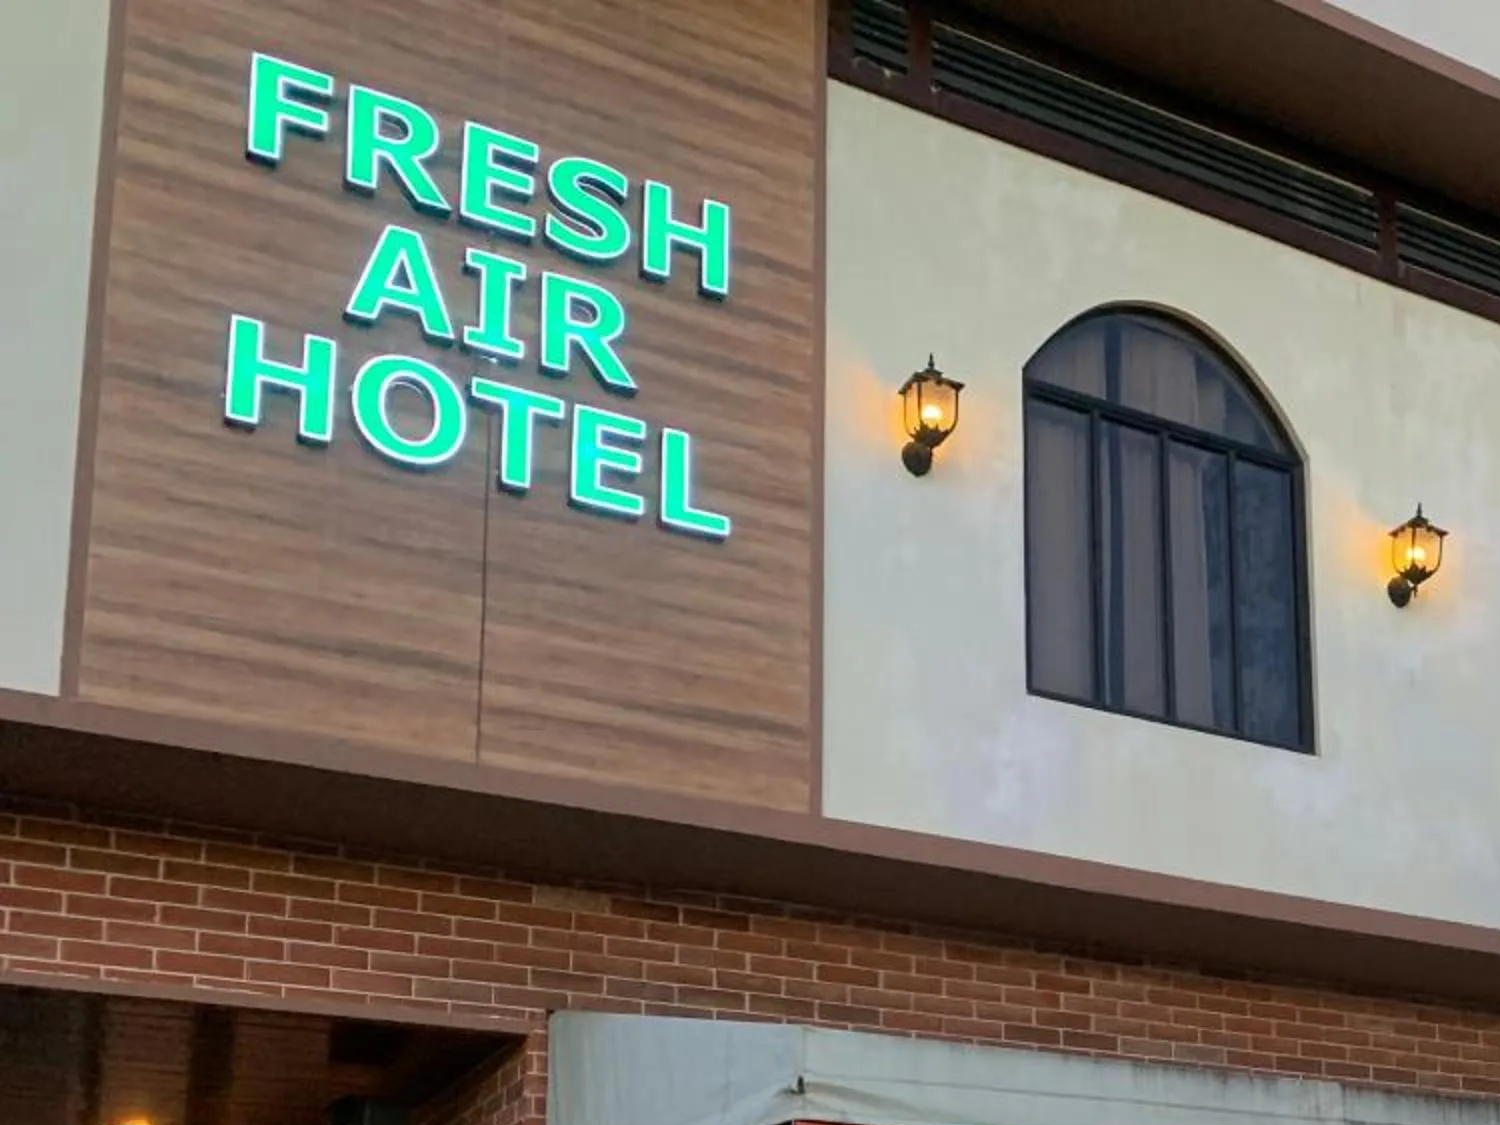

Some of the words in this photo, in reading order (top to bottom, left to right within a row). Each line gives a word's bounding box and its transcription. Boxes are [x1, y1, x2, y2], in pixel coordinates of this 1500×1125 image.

[246, 51, 730, 297] FRESH
[344, 224, 638, 392] AIR
[224, 313, 731, 537] HOTEL
